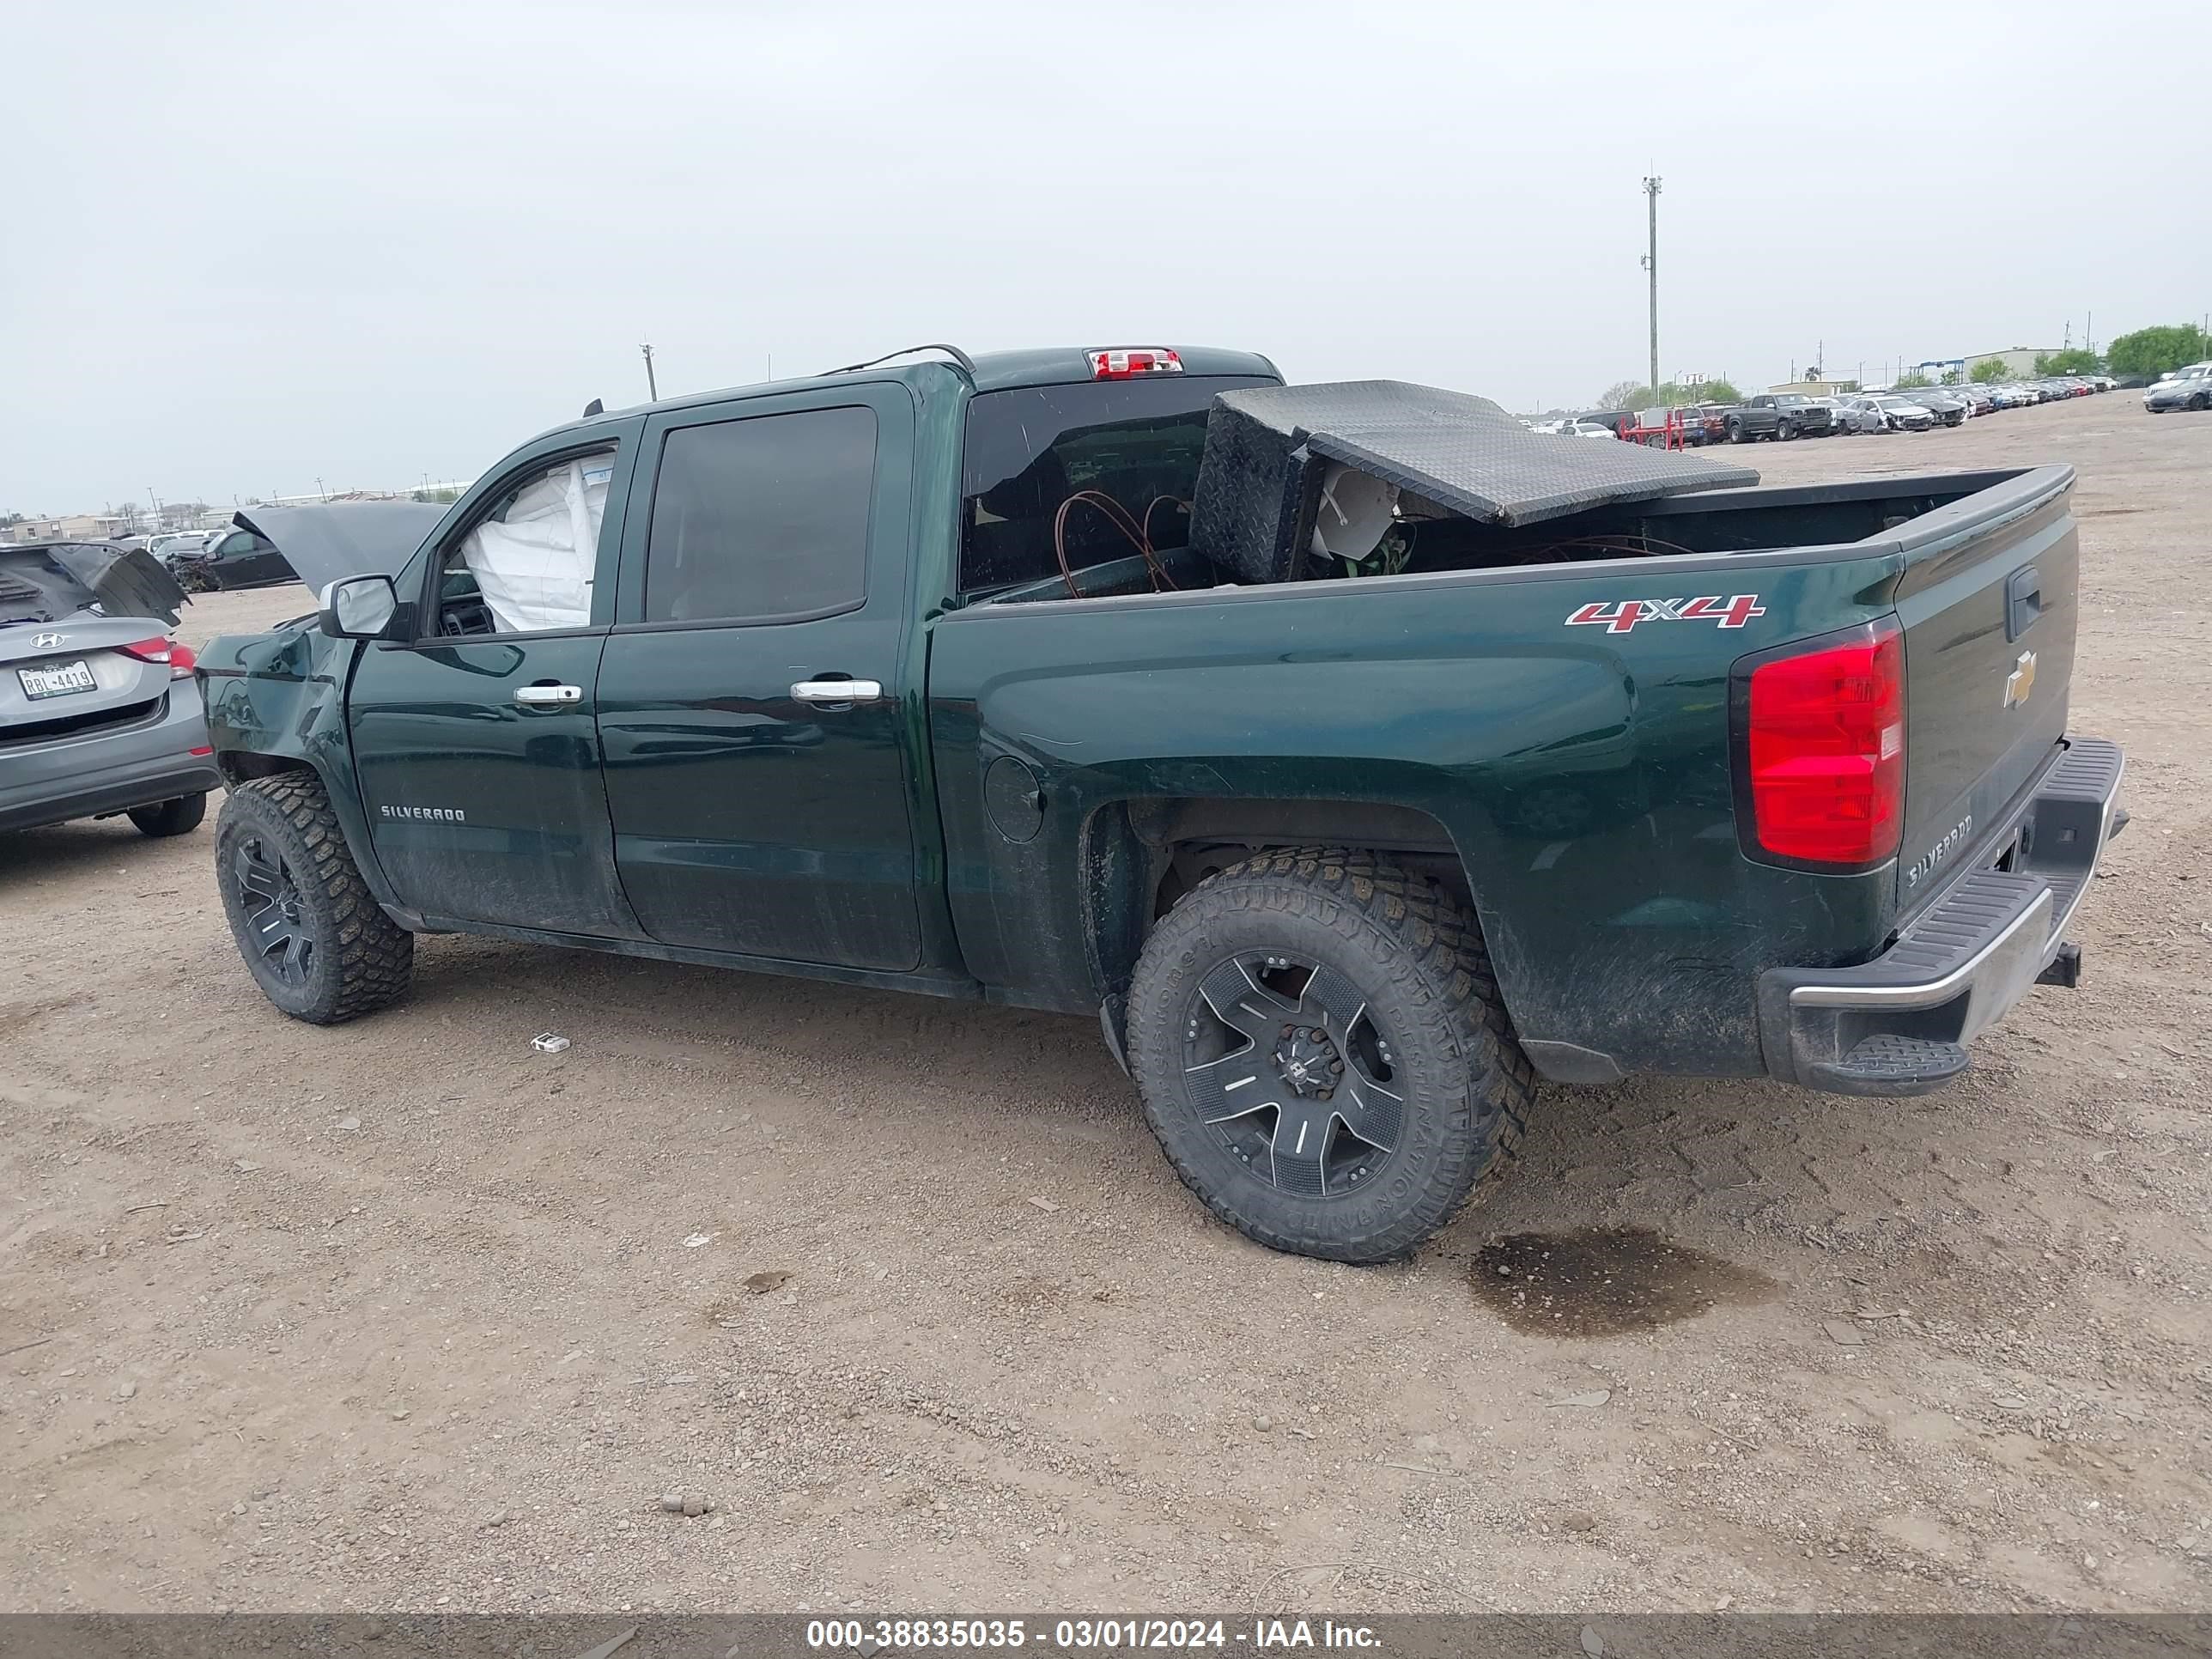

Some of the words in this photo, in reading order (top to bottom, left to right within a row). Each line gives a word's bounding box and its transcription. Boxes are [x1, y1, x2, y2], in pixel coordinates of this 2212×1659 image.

[380, 805, 465, 821] SILVERADO
[1907, 815, 1972, 888] SILVERADO
[1375, 1007, 1431, 1214] DESTINATION
